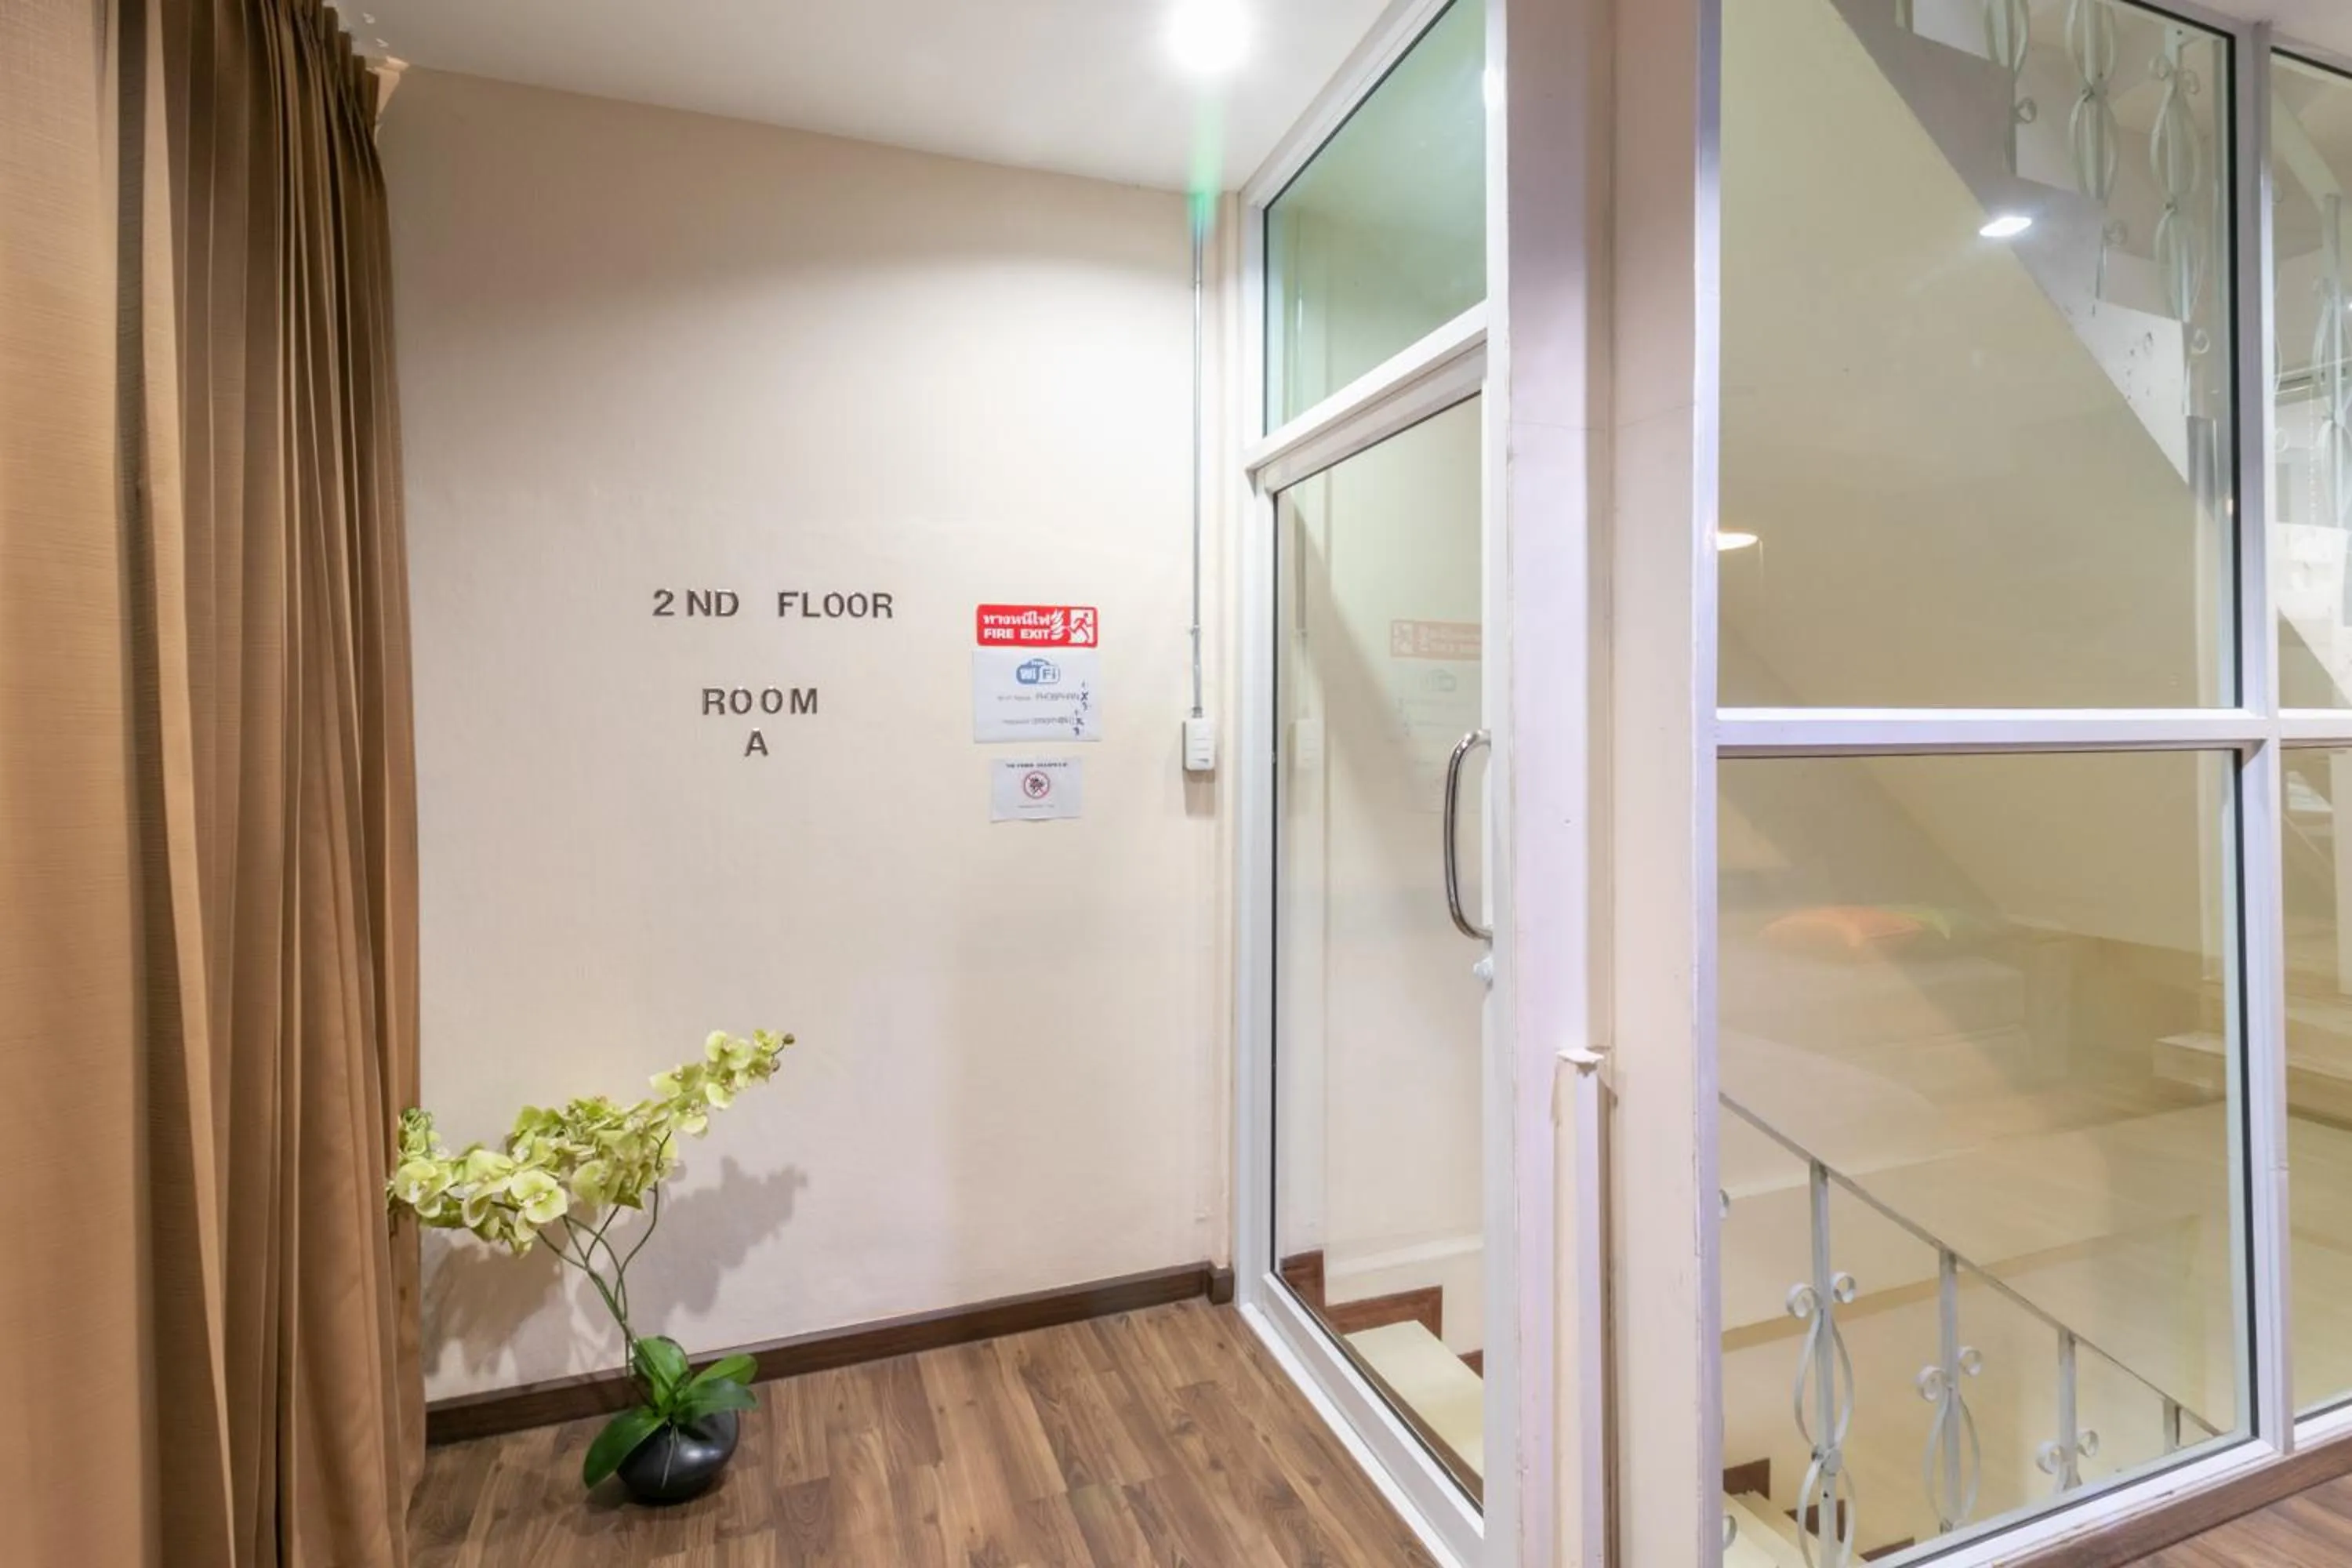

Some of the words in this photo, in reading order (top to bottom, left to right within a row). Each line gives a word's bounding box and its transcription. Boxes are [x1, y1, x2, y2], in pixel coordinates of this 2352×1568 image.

[778, 592, 893, 618] FLOOR
[982, 611, 1051, 626] ทางหนีไฟ
[983, 629, 1014, 639] FIRE
[1021, 629, 1050, 640] EXIT
[702, 688, 818, 715] ROOM
[745, 731, 769, 757] A
